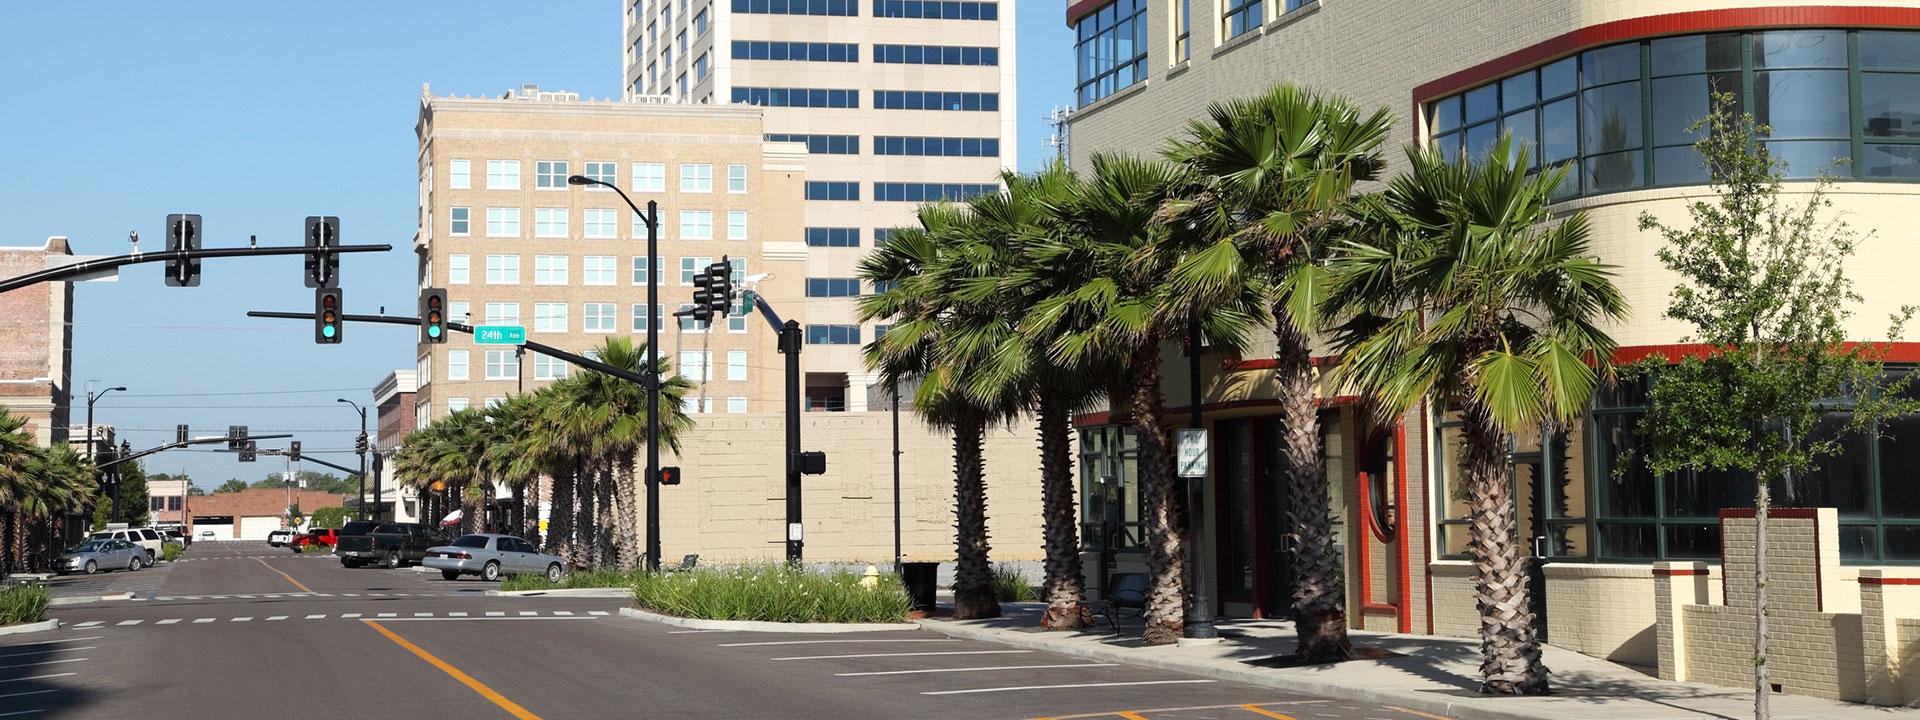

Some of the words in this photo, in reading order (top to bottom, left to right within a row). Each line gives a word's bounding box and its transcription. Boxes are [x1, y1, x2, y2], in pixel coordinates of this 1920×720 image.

[481, 329, 503, 340] 24th
[508, 331, 520, 339] Ave
[1184, 448, 1200, 457] HOUR
[1180, 461, 1205, 470] PARKING
